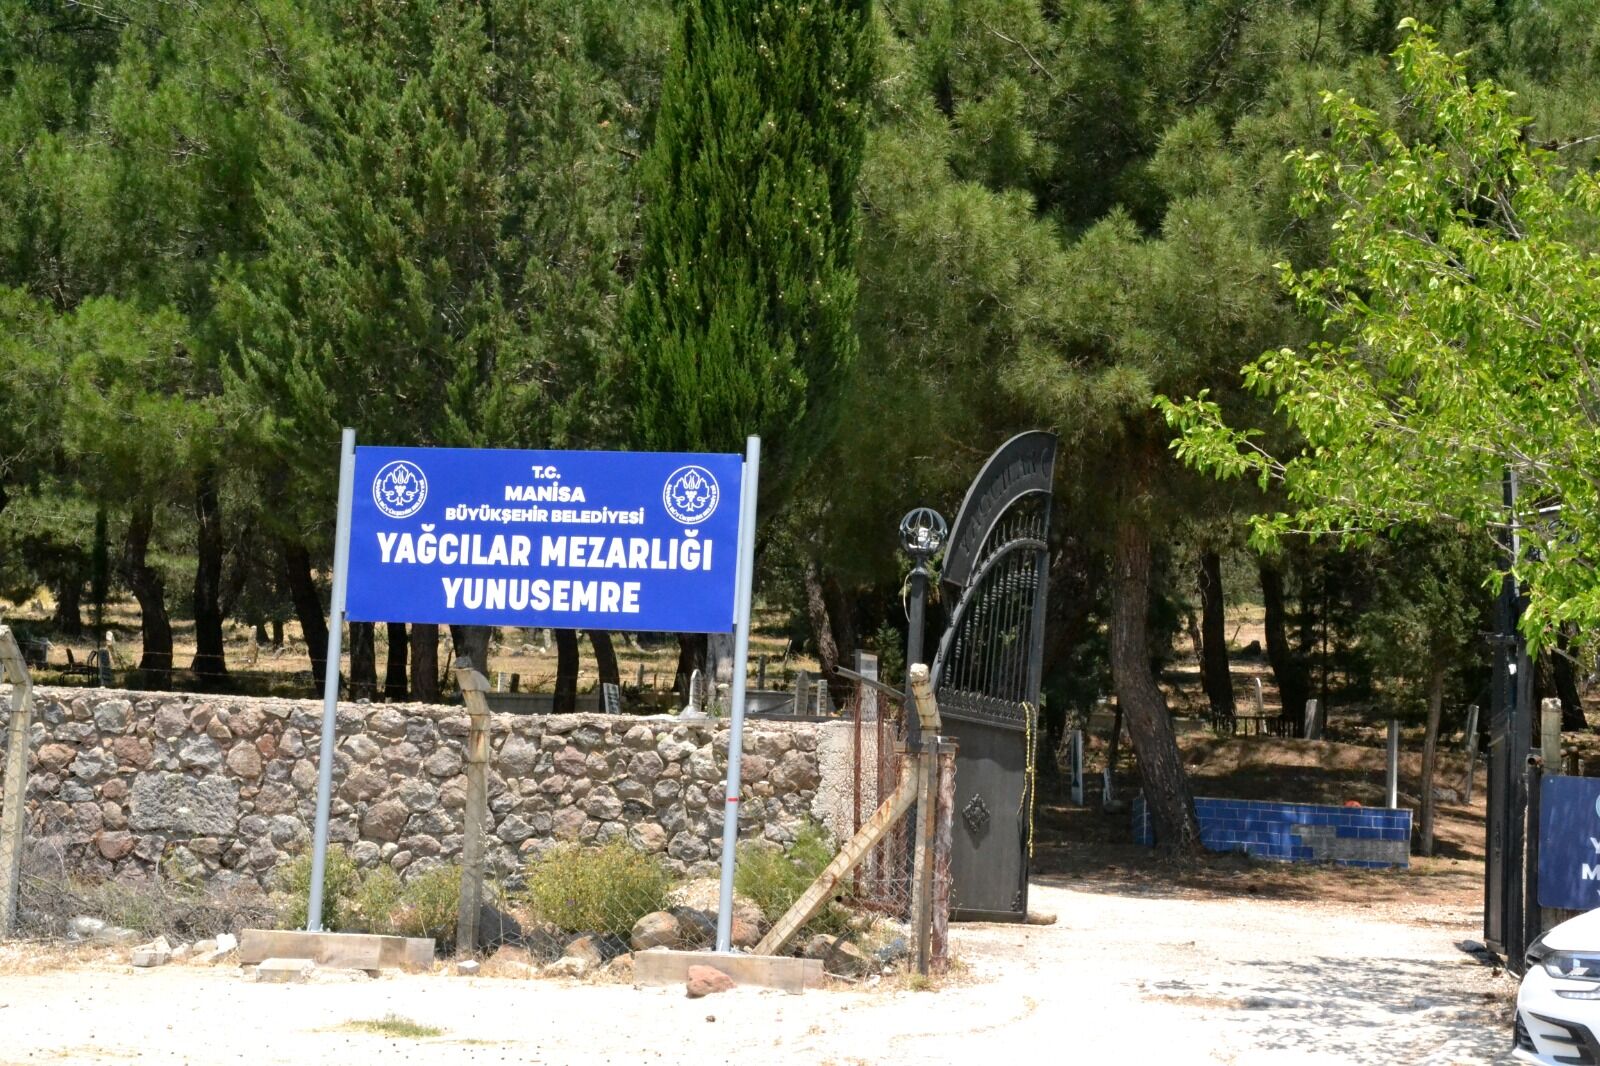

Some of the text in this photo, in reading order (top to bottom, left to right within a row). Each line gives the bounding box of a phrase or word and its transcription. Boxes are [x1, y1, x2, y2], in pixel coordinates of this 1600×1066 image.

[531, 465, 561, 479] T.C.
[504, 481, 586, 503] MANİSA
[445, 504, 645, 525] BÜYÜKŞEHİR BELEDİYESİ
[376, 523, 713, 571] YAĞCILAR MEZARLIĞI
[441, 577, 641, 614] YUNUSEMRE
